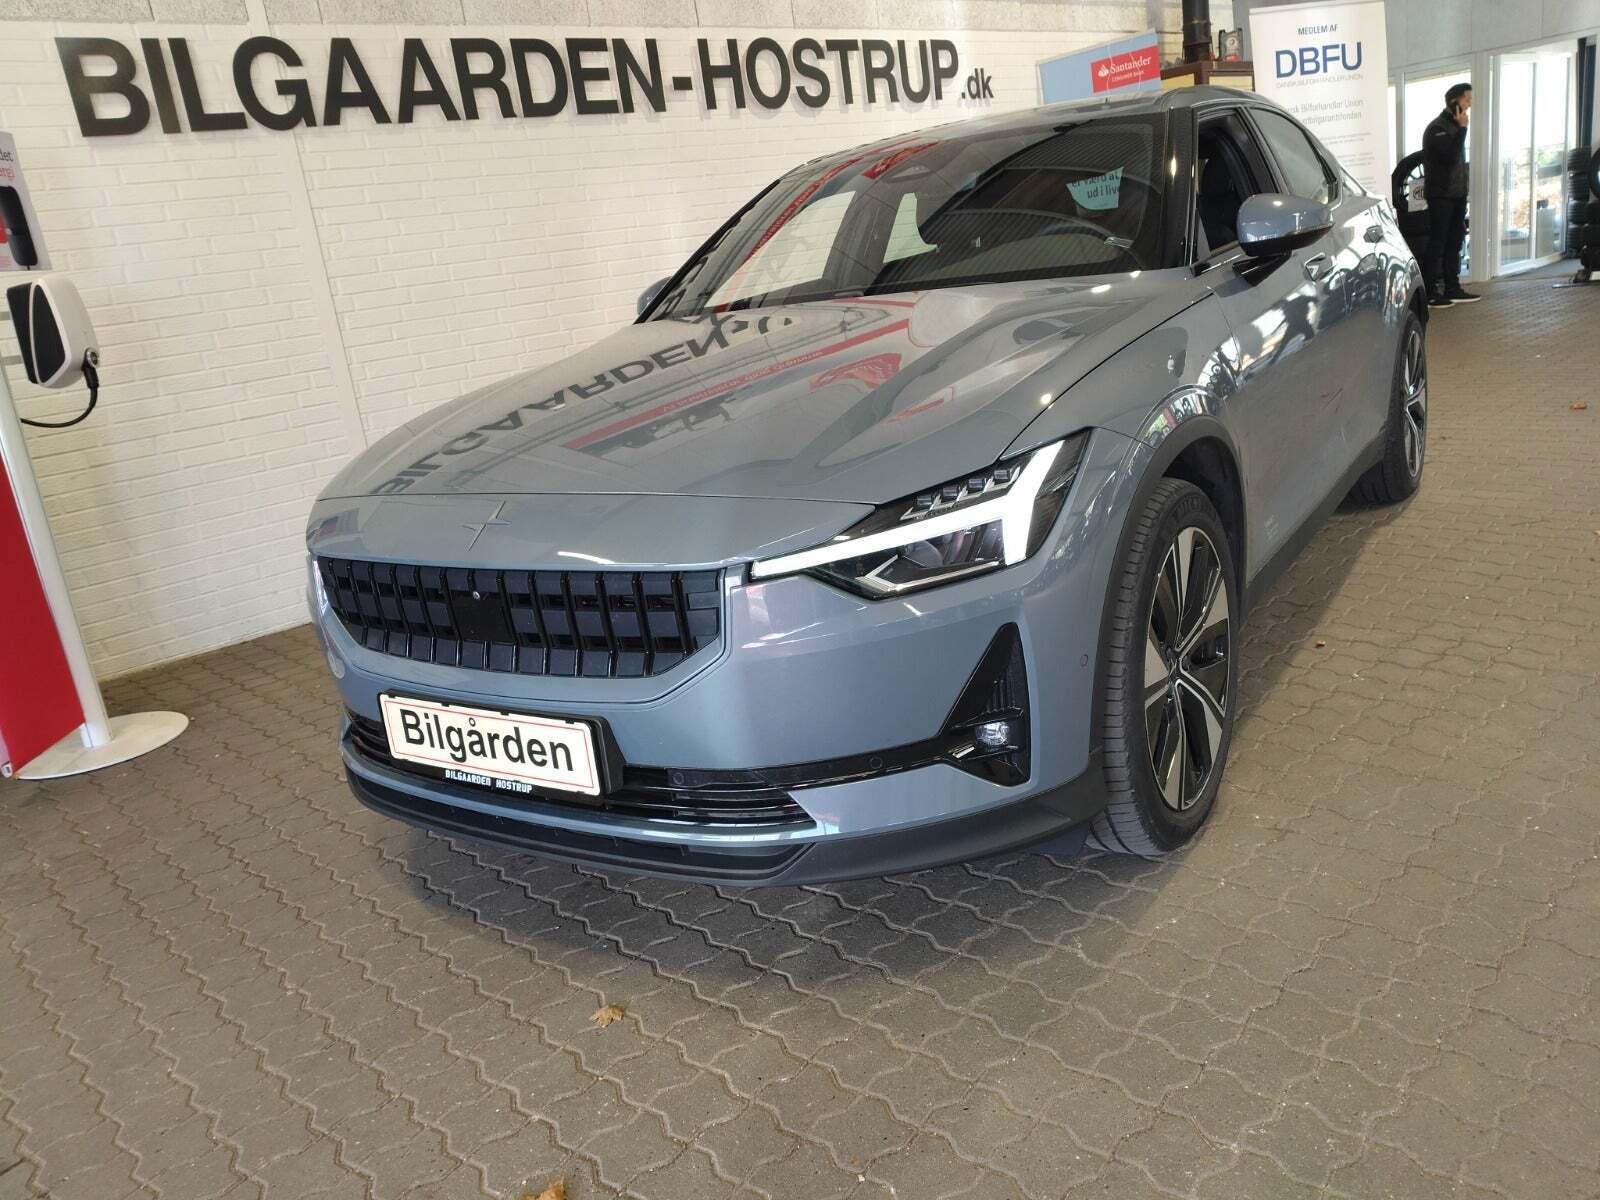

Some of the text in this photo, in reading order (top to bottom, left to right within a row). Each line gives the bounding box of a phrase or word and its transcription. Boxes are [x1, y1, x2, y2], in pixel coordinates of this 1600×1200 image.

[1298, 23, 1338, 35] MEDLEM AF
[1110, 56, 1151, 74] Santander
[1275, 42, 1362, 78] DBFU
[400, 708, 575, 772] Bilgården
[495, 779, 533, 794] HOSTRUP
